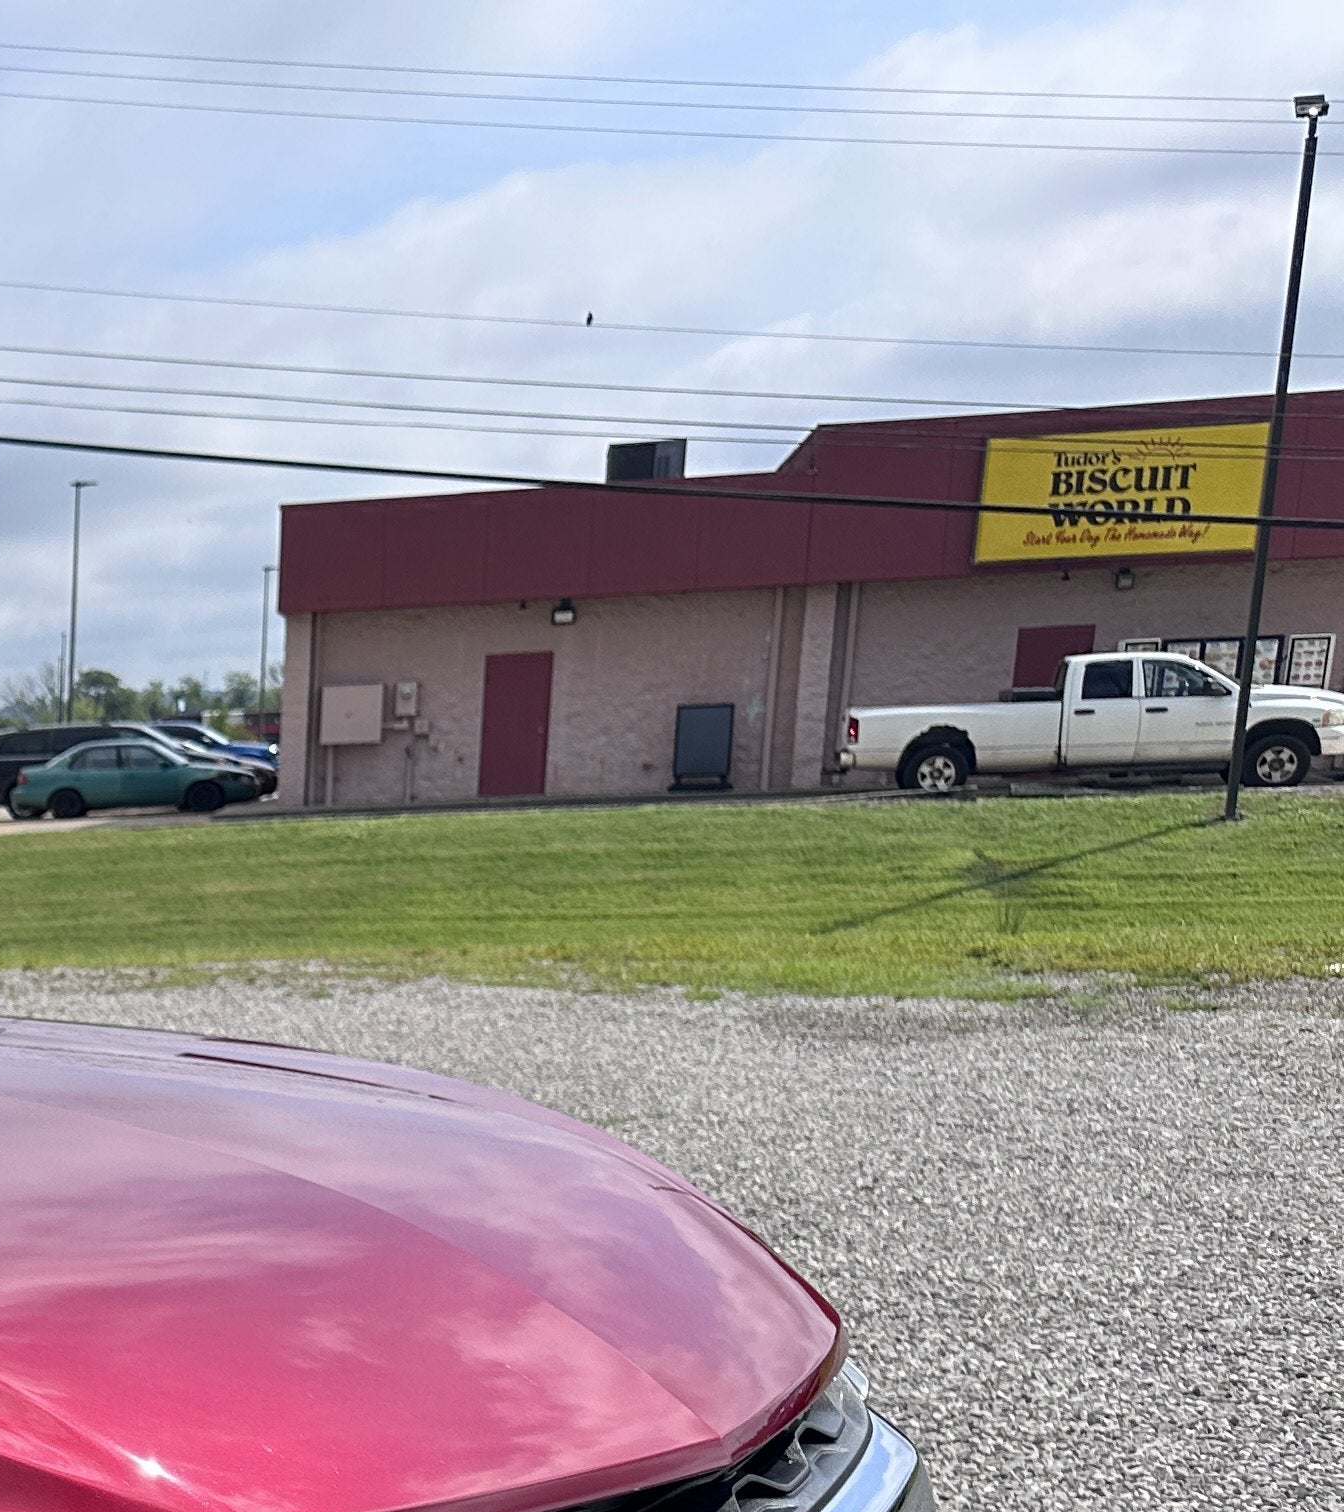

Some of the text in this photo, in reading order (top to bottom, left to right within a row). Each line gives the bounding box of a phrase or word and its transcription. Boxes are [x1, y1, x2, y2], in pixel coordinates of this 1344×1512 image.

[1054, 449, 1121, 467] Tudor's
[1049, 463, 1197, 497] BISCUIT
[1048, 496, 1191, 527] WORLD
